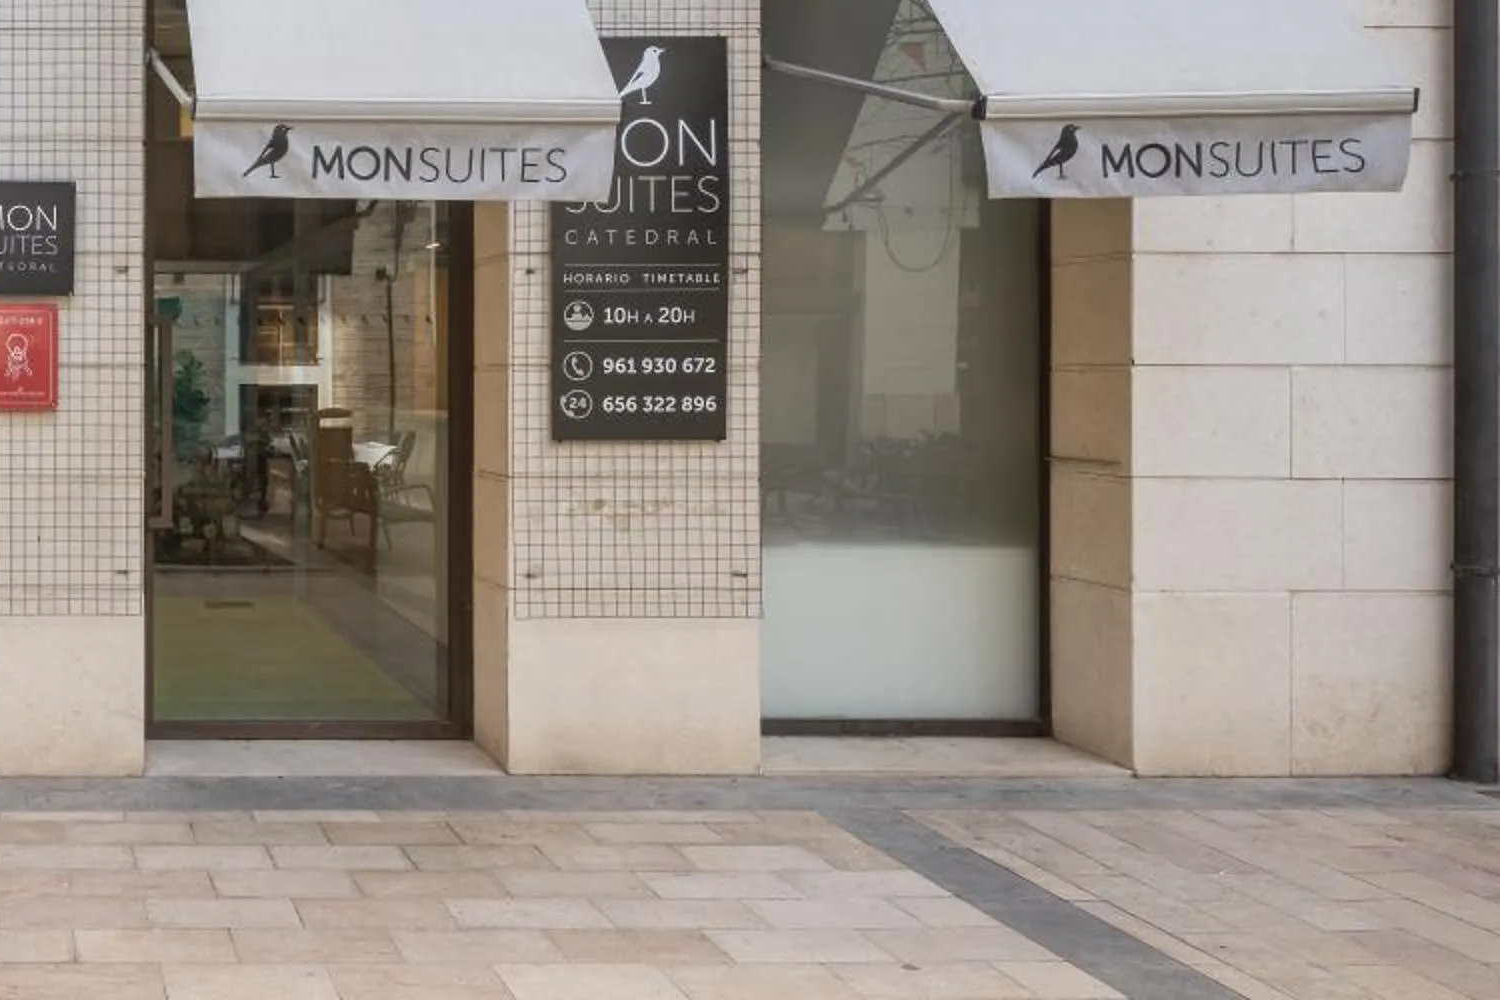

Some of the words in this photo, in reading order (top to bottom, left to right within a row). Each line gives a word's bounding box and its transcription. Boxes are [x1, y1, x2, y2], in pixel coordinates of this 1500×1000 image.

[621, 117, 717, 168] ON
[311, 145, 568, 183] MONSUITES
[1100, 138, 1366, 179] MONSUITES
[565, 175, 721, 213] UITES
[565, 229, 717, 245] CATEDRAL
[563, 273, 631, 284] HORARIO
[643, 273, 721, 284] TIMETABLE
[603, 307, 639, 324] 10H
[644, 313, 653, 323] A
[658, 307, 695, 324] 20H
[603, 357, 637, 374] 961
[641, 357, 677, 374] 930
[682, 357, 716, 374] 672
[603, 396, 637, 413] 656
[642, 396, 676, 413] 322
[681, 396, 717, 413] 896
